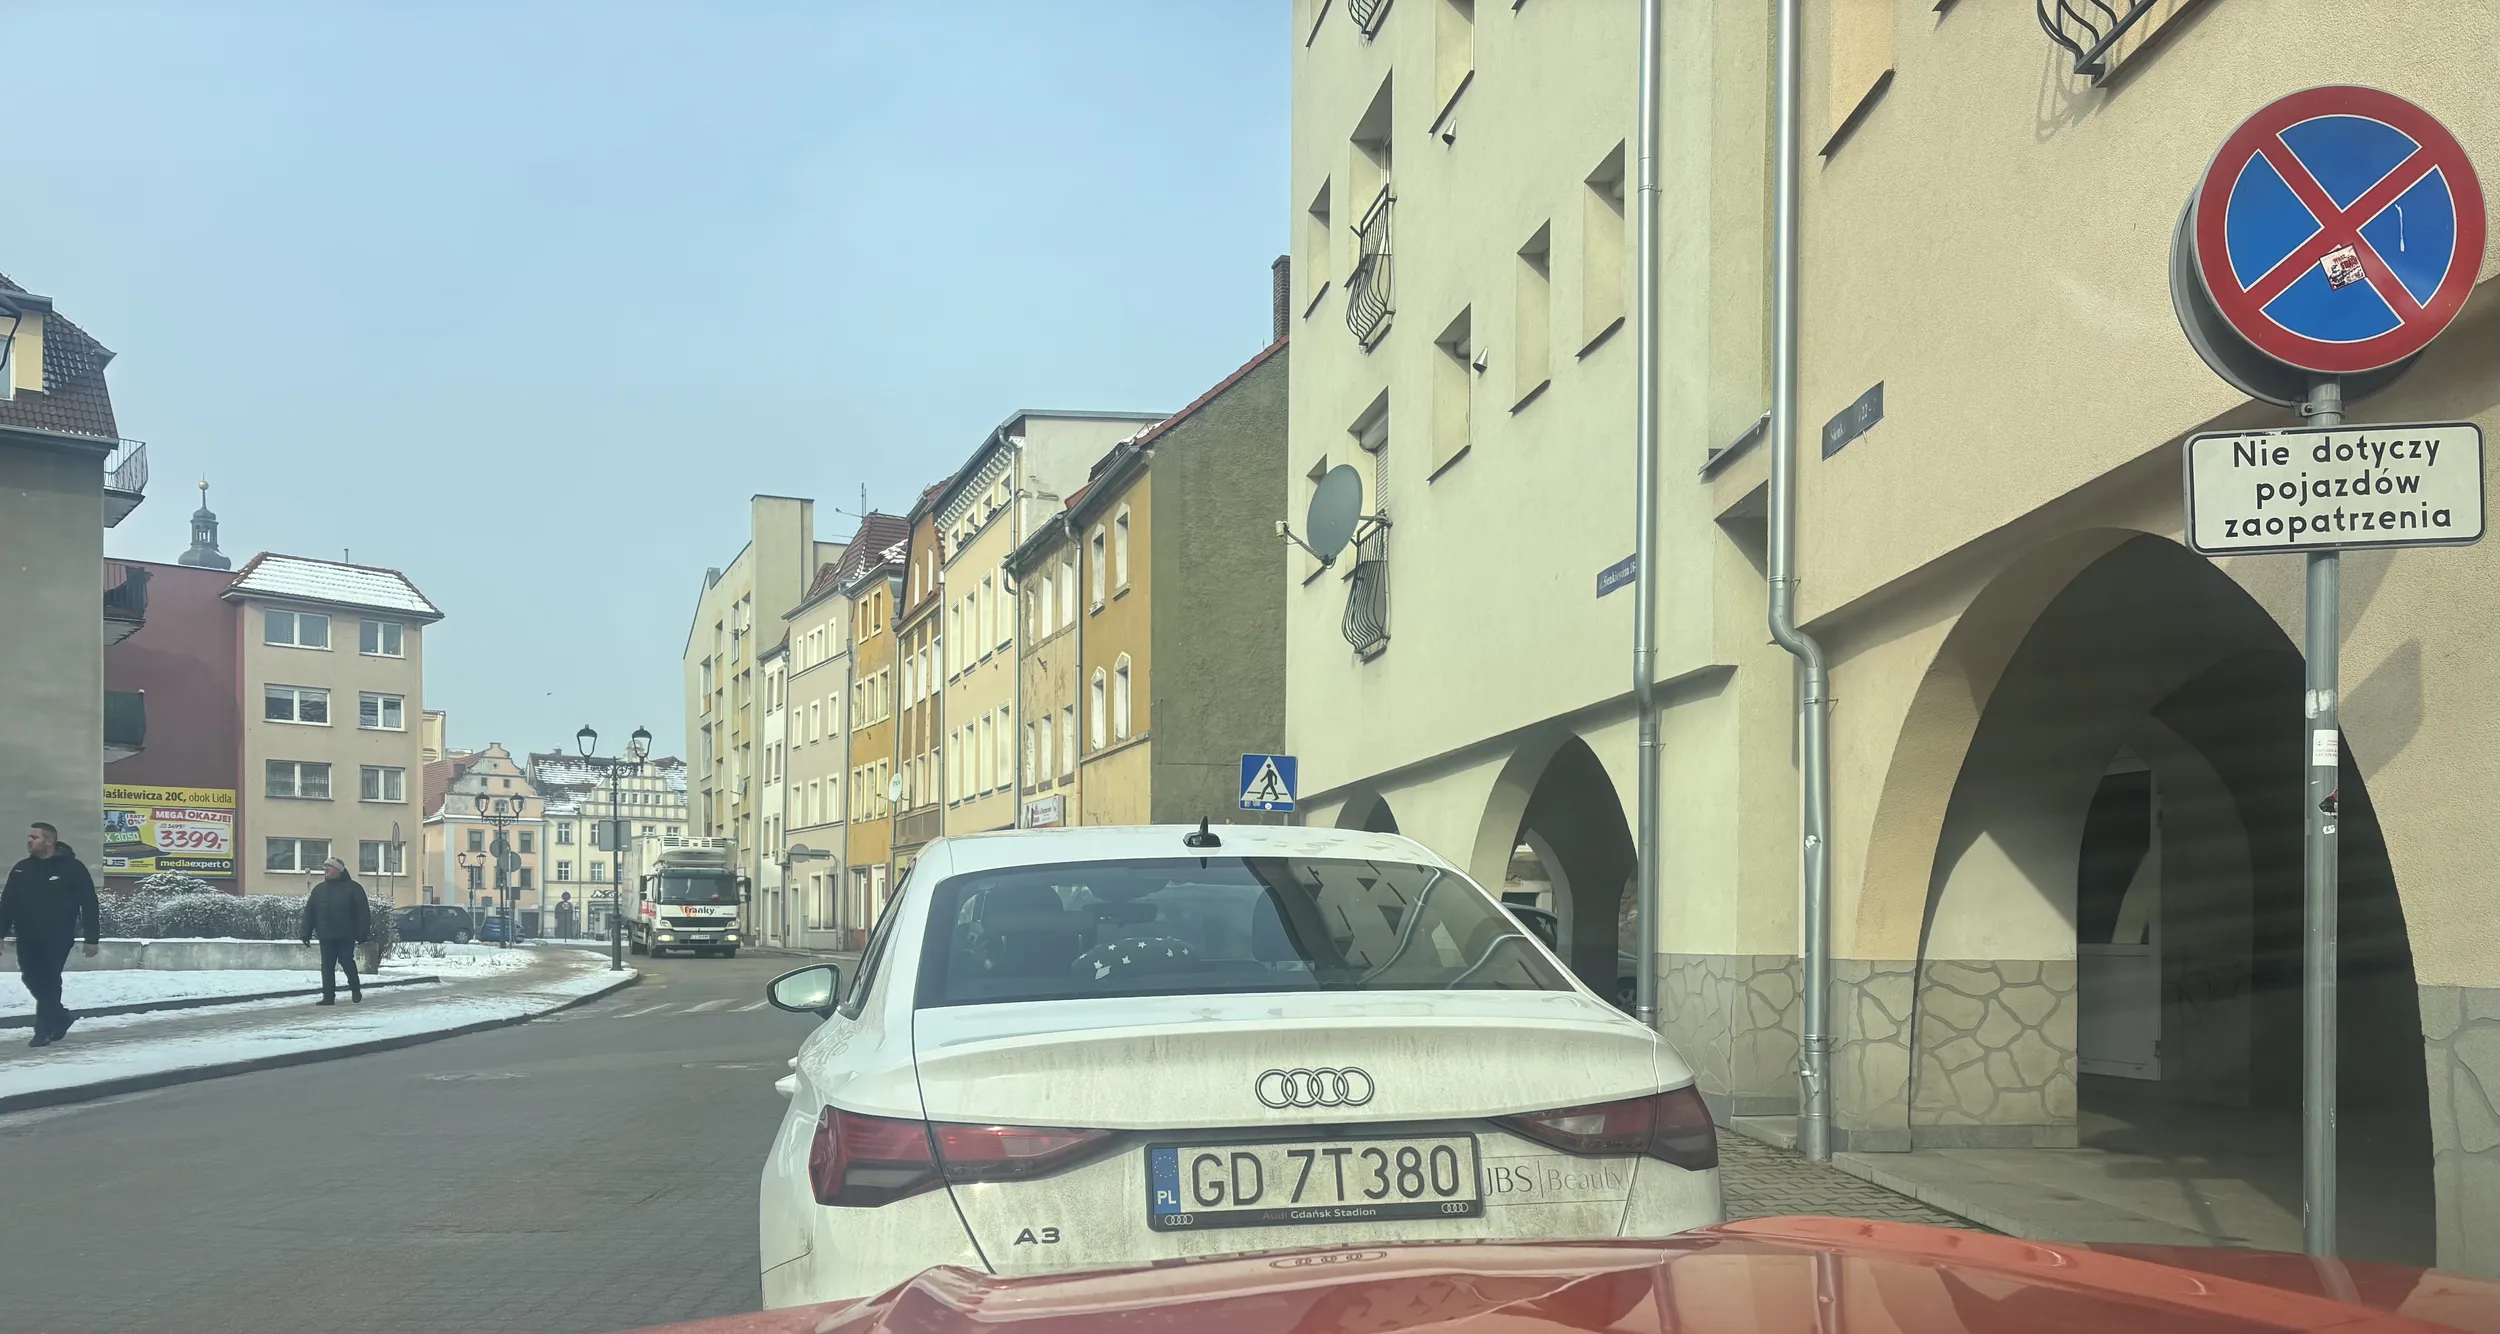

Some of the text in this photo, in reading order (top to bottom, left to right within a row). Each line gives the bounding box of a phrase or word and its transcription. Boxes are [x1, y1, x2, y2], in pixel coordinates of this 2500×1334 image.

[2233, 435, 2440, 468] Nie dotyczy
[2256, 468, 2420, 509] pojazdów
[2225, 502, 2451, 542] zaopatrzenia
[188, 792, 210, 803] obok
[212, 793, 232, 803] Lidla
[155, 810, 232, 823] MEGA OKAZJE!
[115, 831, 139, 842] 3050
[160, 860, 221, 869] mediaexpert
[684, 906, 715, 915] Franky
[1157, 1144, 1460, 1207] PL GD 7T380
[1484, 1165, 1533, 1196] JBS
[1262, 1207, 1376, 1220] Audi Gdańsk Stadion
[1013, 1227, 1061, 1246] A3
